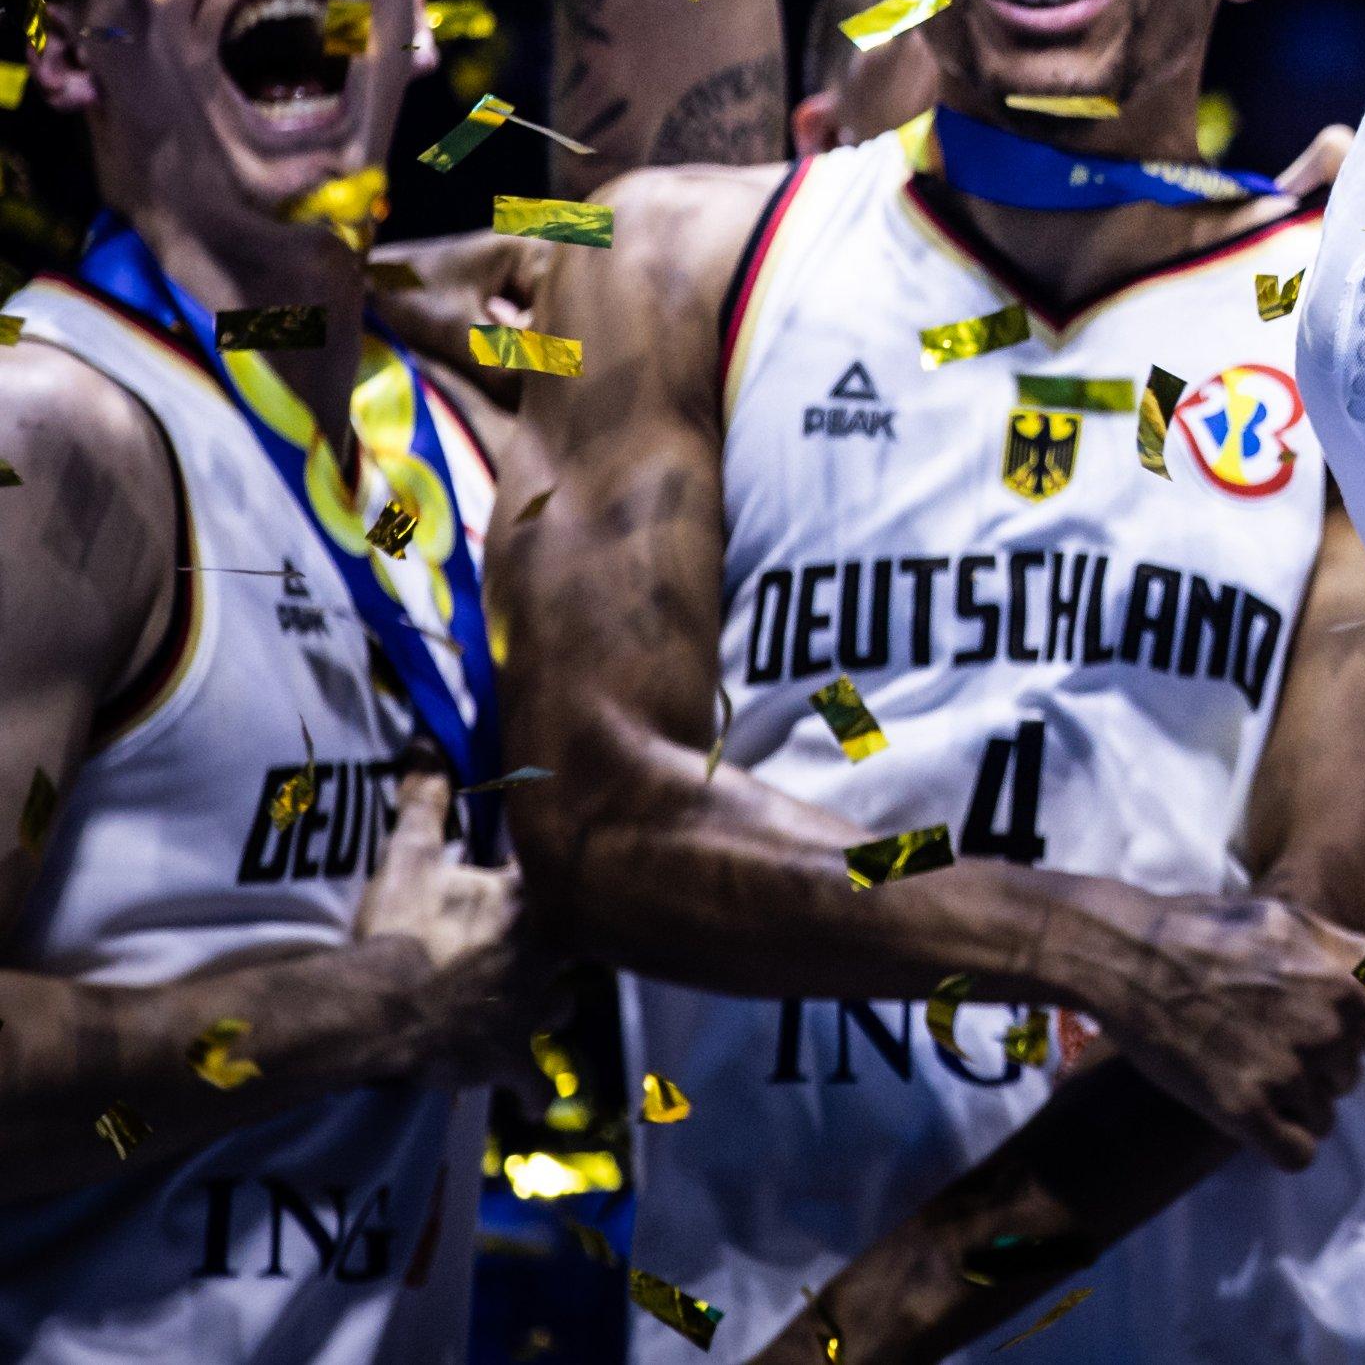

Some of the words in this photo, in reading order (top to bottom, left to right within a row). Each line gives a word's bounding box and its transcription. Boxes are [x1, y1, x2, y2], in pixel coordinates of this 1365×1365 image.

[802, 407, 896, 441] PEAK
[746, 550, 1282, 712] DEUTSCHLAND
[959, 719, 1046, 862] 4
[192, 1175, 396, 1285] ING
